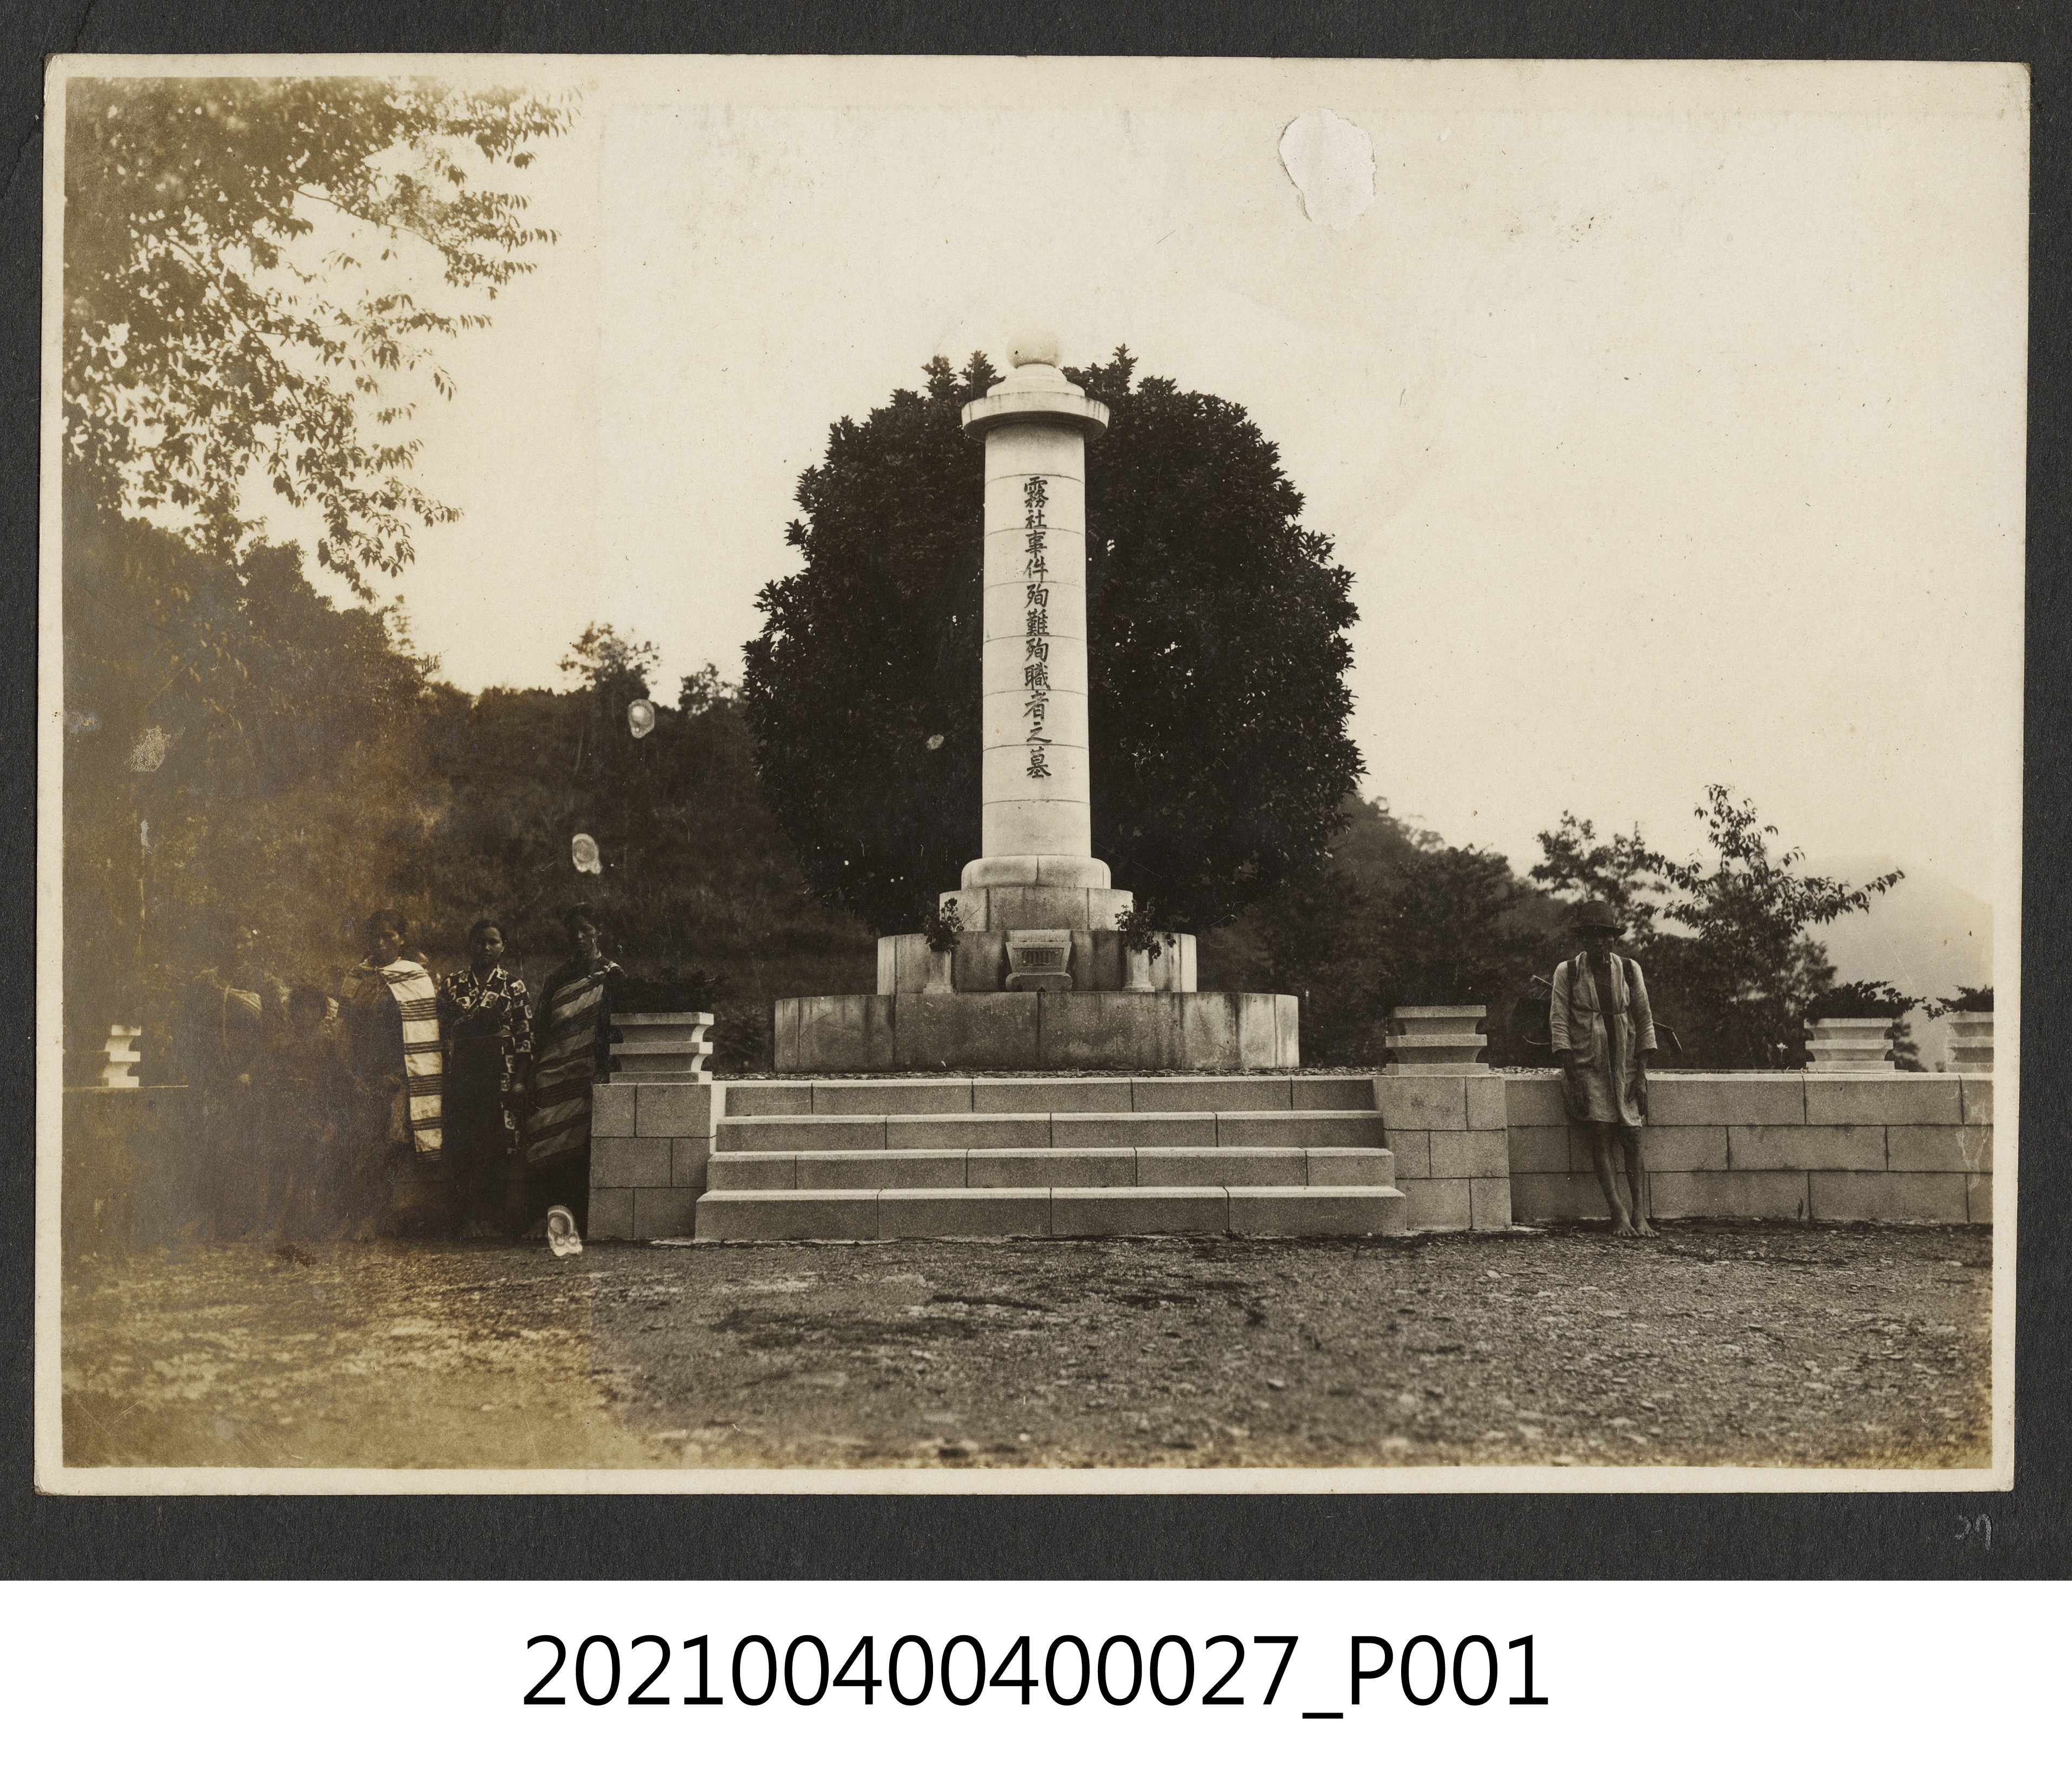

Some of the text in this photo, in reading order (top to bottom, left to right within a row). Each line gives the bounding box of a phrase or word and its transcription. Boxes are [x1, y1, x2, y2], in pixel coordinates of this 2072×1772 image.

[1023, 476, 1052, 779] 霧社事件殉難殉職者之墓
